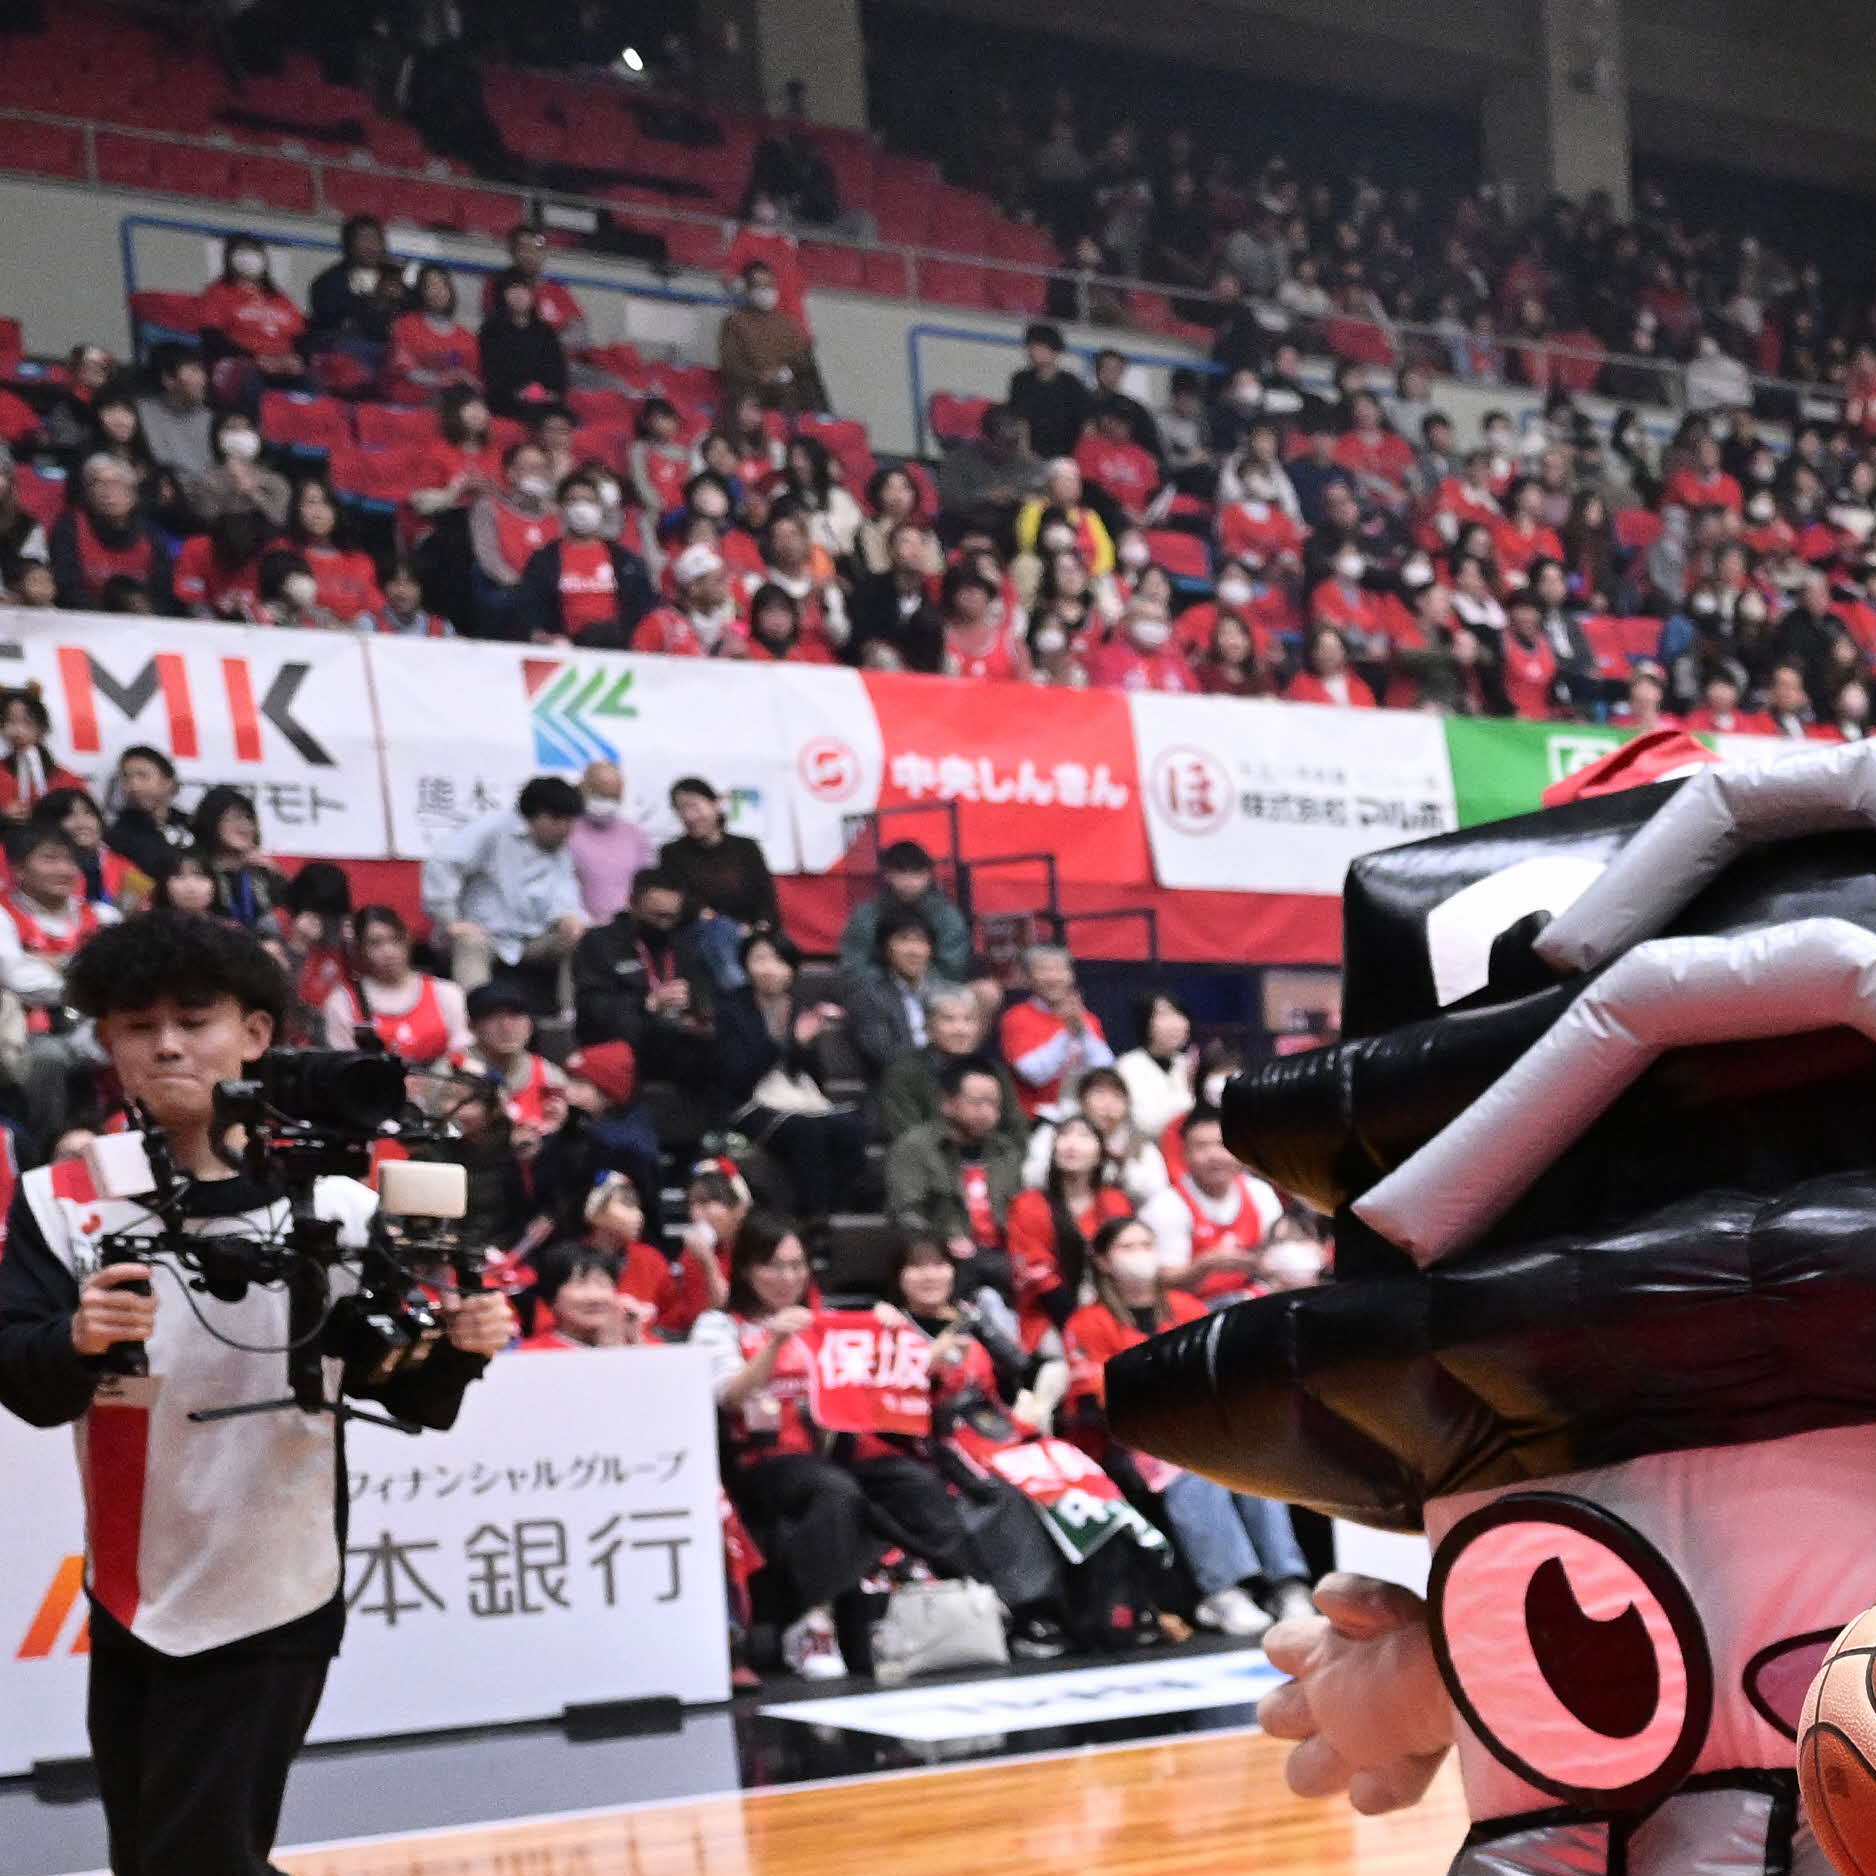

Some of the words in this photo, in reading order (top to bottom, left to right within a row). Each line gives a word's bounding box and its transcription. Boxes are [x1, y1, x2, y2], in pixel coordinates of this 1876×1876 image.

[0, 643, 337, 767] MK
[890, 750, 1129, 809] 中央しんきん
[346, 1511, 692, 1627] 本銀行
